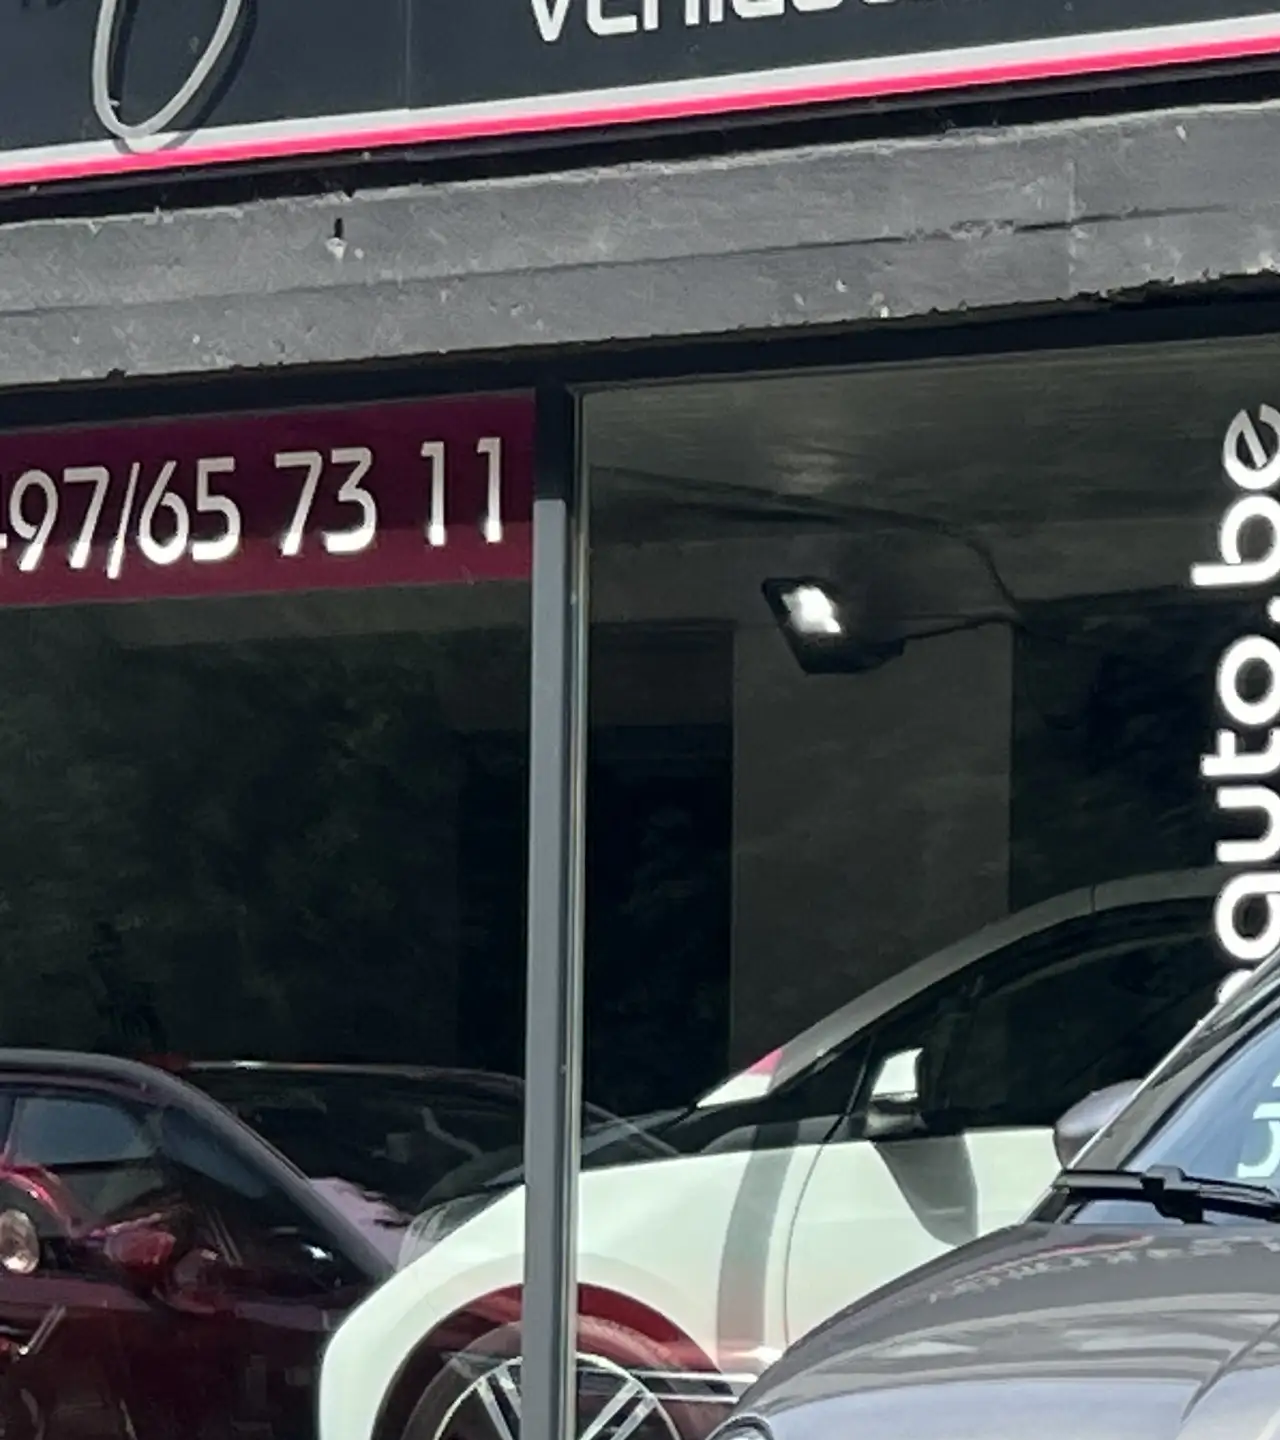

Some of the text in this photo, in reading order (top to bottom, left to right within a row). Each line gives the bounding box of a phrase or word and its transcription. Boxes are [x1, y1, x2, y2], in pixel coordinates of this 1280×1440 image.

[0, 437, 502, 580] 97/65 73 11
